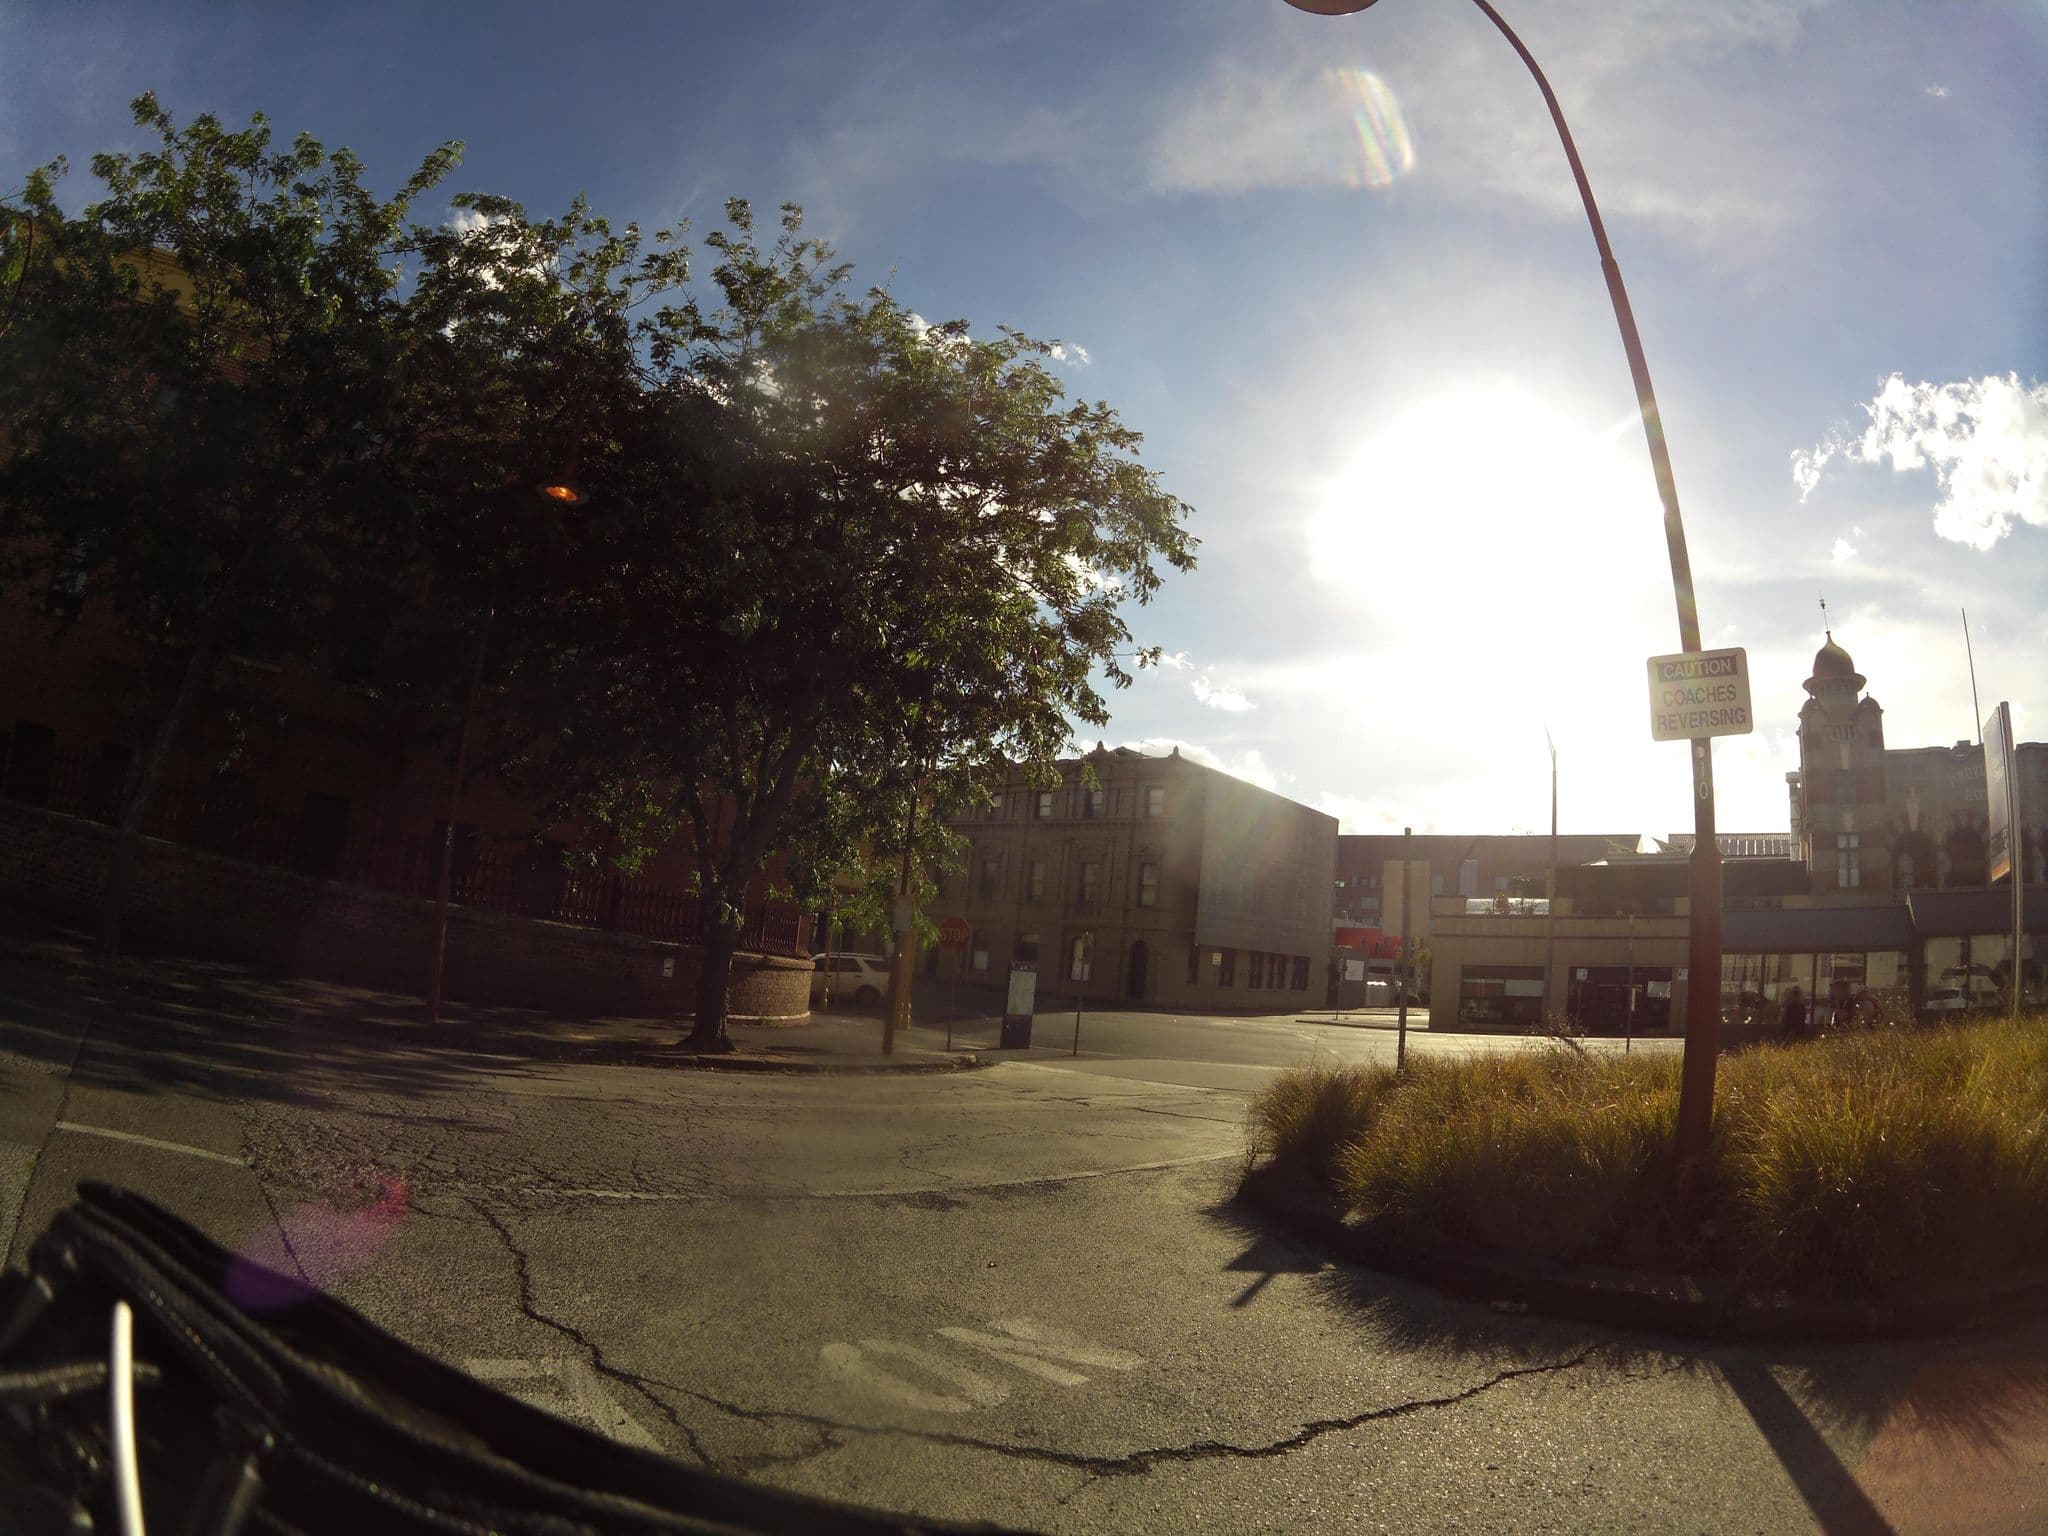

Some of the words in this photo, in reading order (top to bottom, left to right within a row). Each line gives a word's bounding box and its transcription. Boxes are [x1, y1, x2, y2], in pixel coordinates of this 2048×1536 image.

[1663, 659, 1731, 678] CAUTION
[1663, 684, 1737, 707] COACHES
[1657, 707, 1747, 731] REVERSING
[941, 927, 968, 942] STOP
